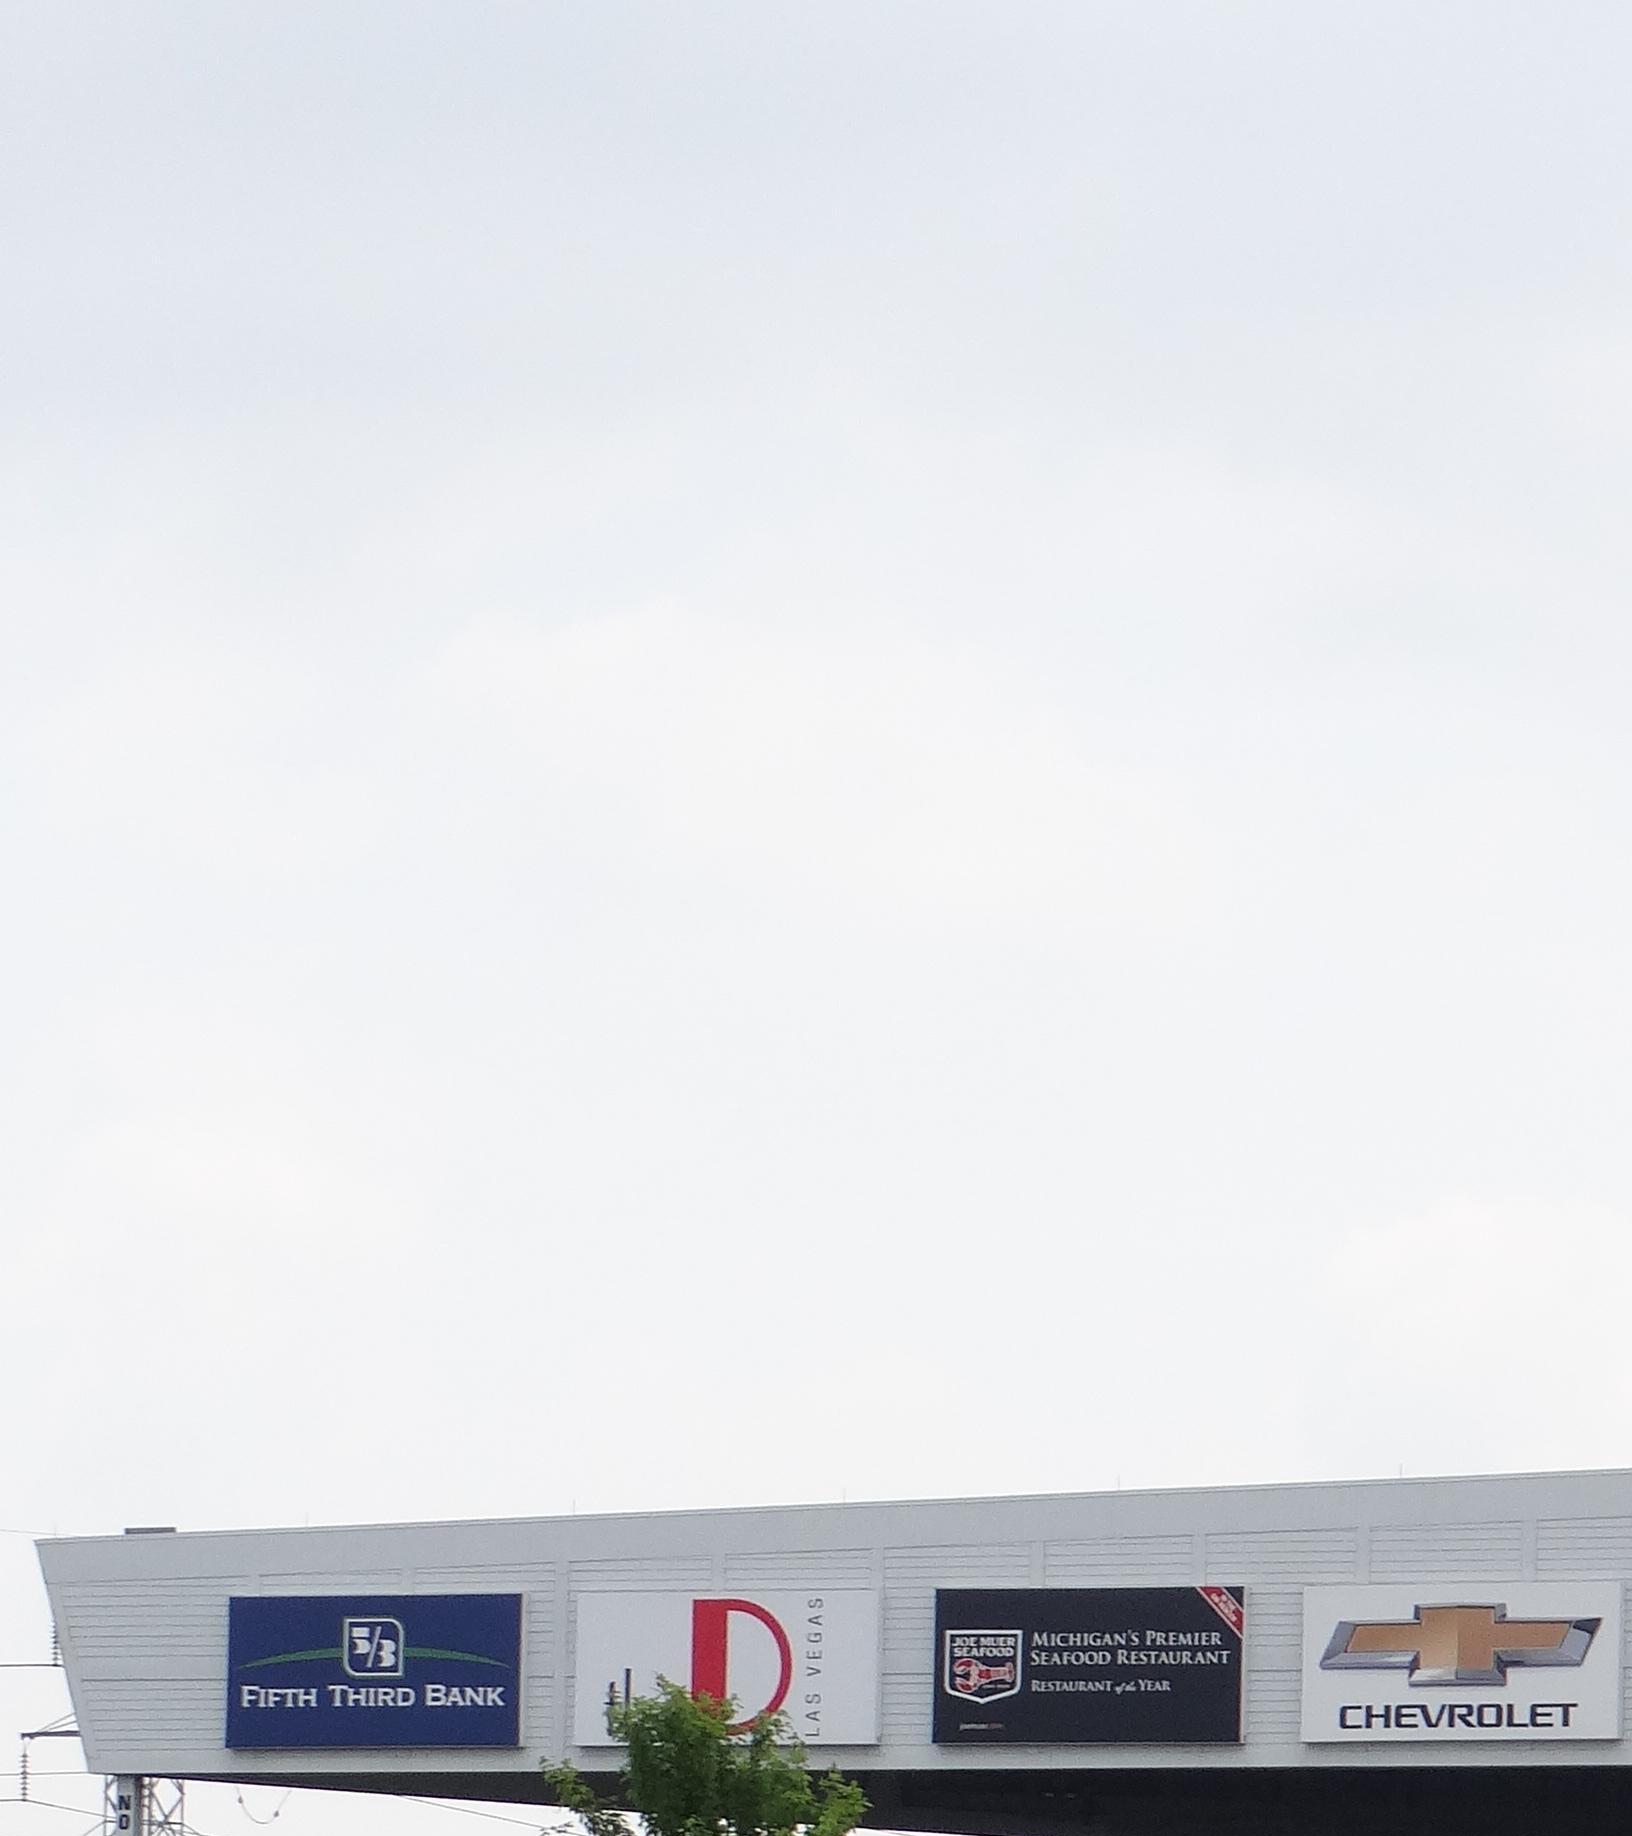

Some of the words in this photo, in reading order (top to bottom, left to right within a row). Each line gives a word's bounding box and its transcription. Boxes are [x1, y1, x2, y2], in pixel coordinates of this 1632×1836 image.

[806, 1597, 824, 1677] VEGAS
[951, 1636, 976, 1648] JOE
[979, 1636, 1016, 1647] MUER
[1031, 1629, 1140, 1647] MICHIGAN'S
[1145, 1630, 1222, 1646] PREMIER
[953, 1647, 1015, 1657] SEAFOOD
[1030, 1650, 1111, 1666] SEAFOOD
[1116, 1649, 1231, 1665] RESTAURANT
[692, 1598, 792, 1736] D
[240, 1685, 318, 1708] FIFTH
[328, 1684, 416, 1707] THIRD
[424, 1684, 505, 1707] BANK
[1031, 1679, 1113, 1692] RESTAURANT
[1138, 1679, 1171, 1692] YEAR
[804, 1692, 821, 1738] LAS
[1339, 1703, 1578, 1730] CHEVROLET
[118, 1795, 131, 1831] NO
